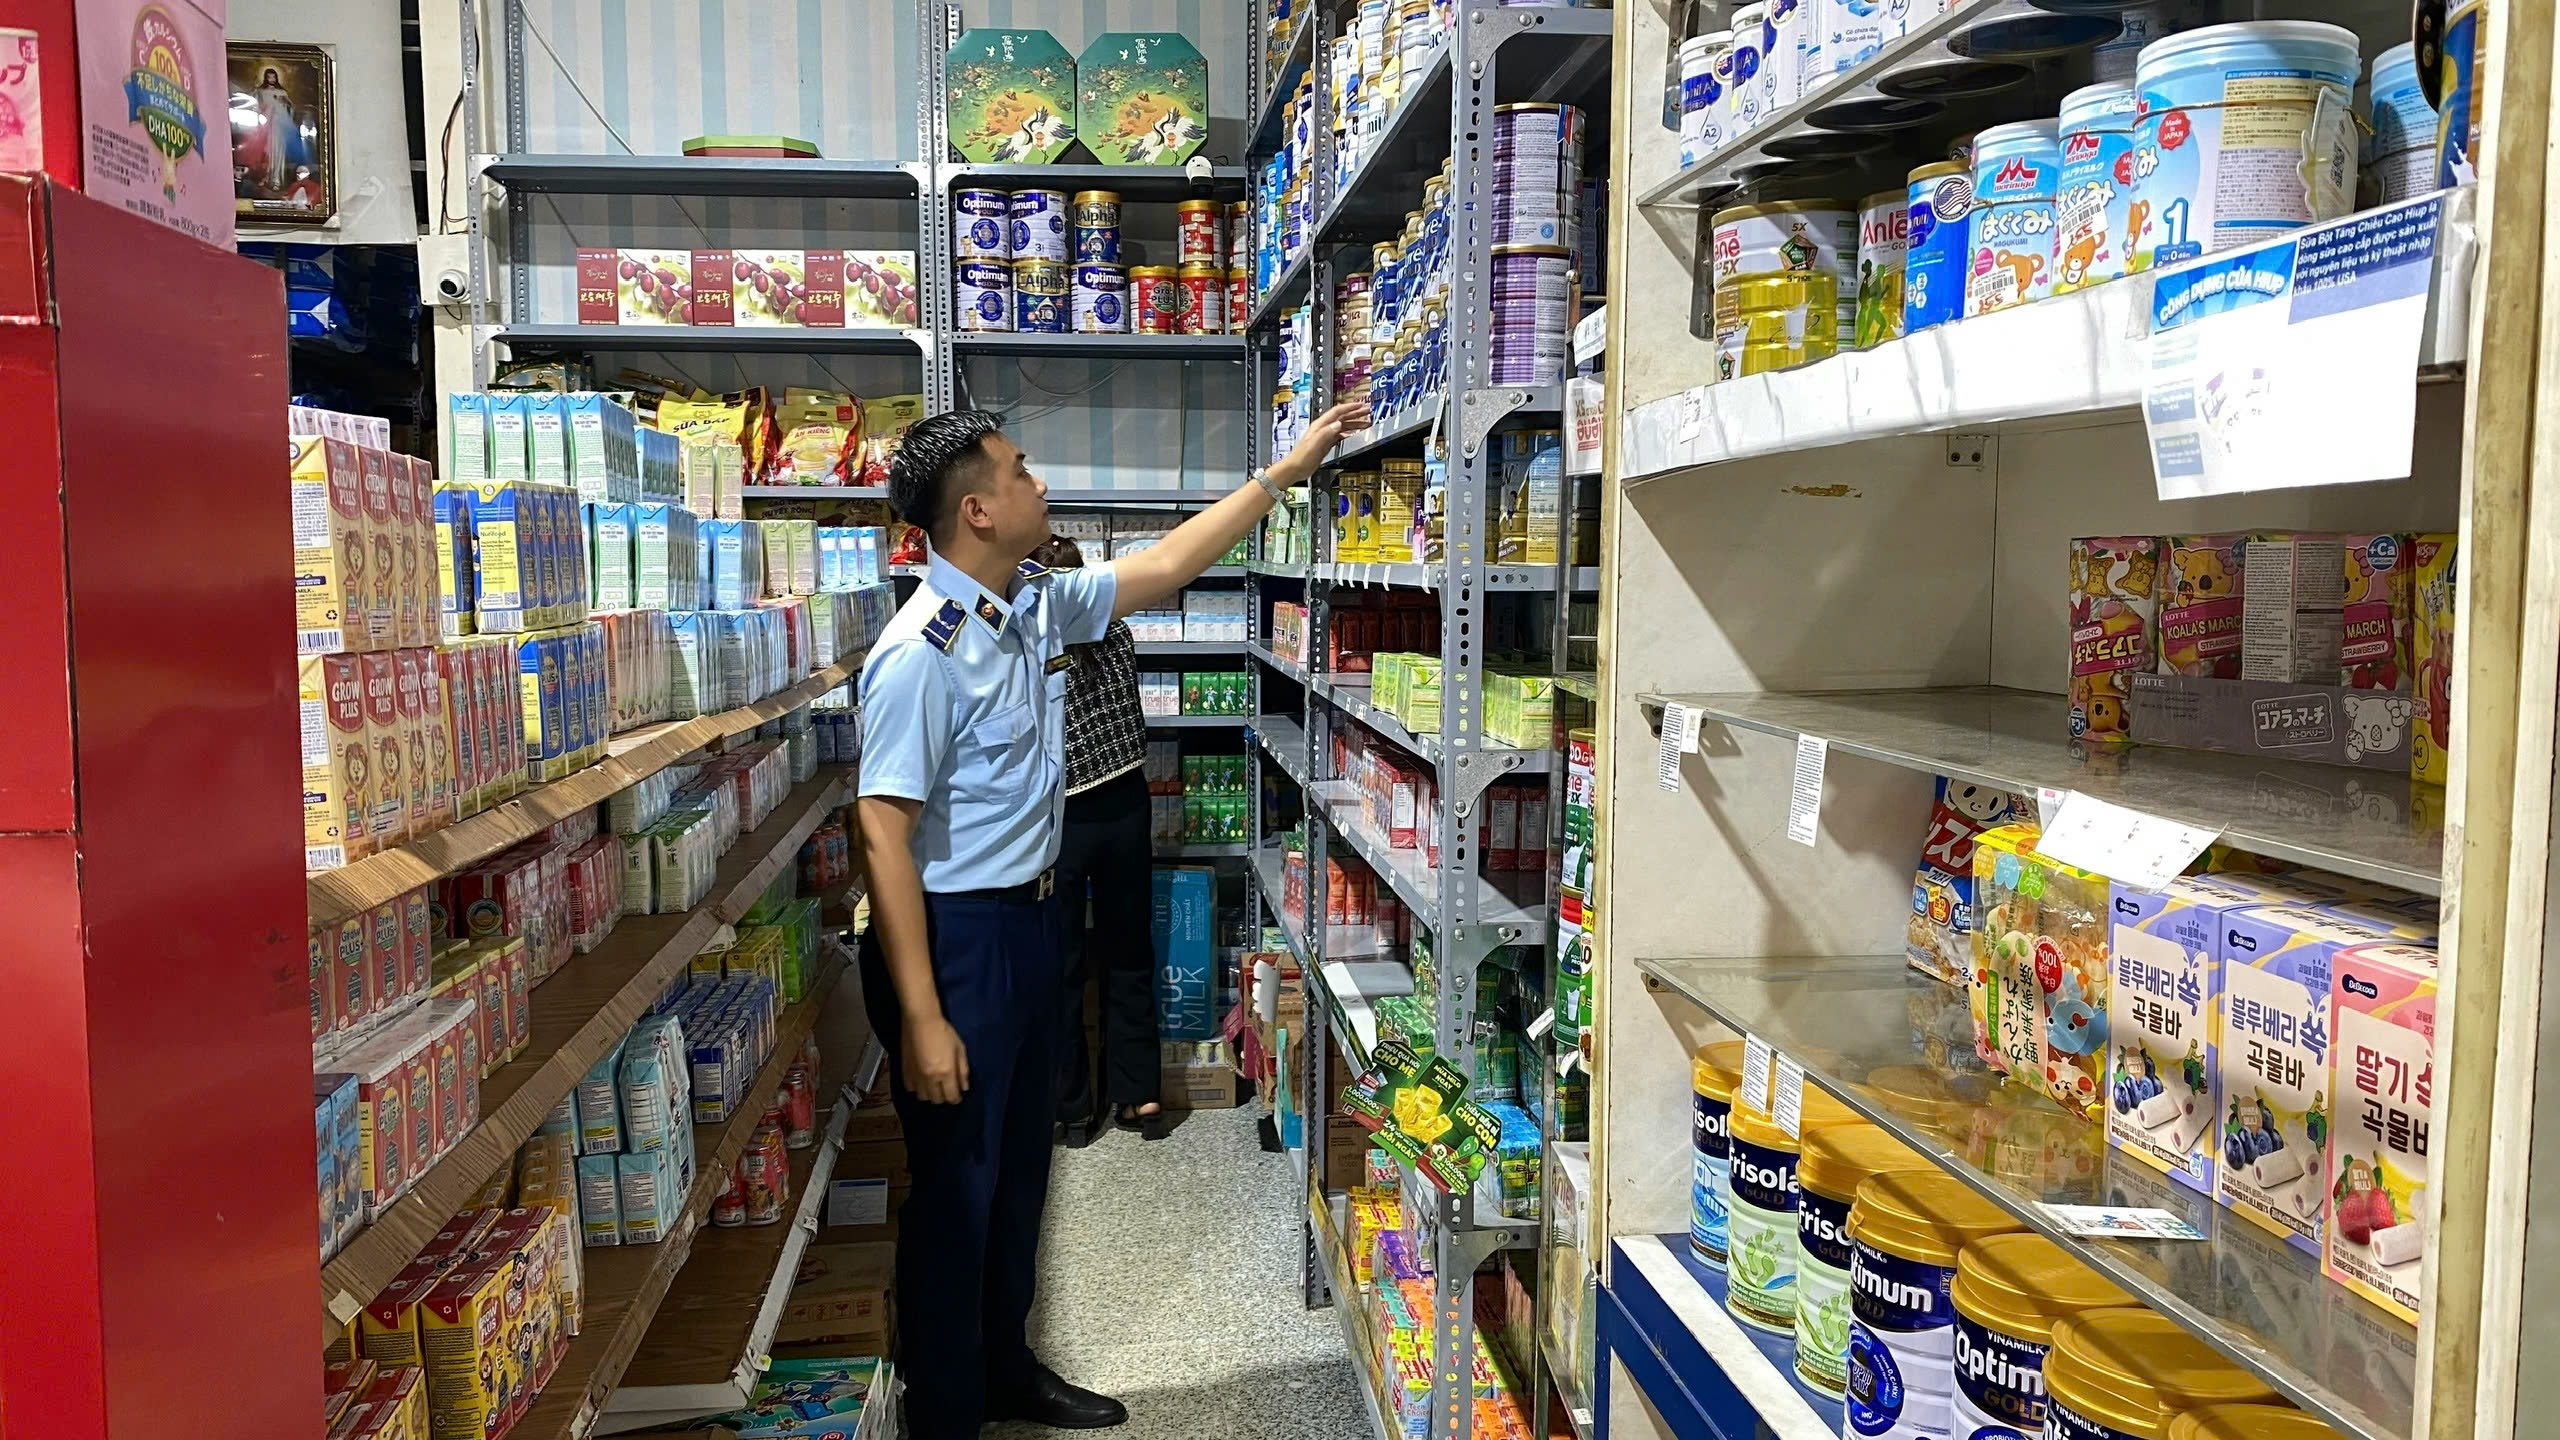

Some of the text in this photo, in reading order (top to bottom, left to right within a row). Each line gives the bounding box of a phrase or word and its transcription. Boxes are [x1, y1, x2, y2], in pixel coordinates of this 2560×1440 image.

[1899, 19, 1906, 37] 1
[1703, 128, 1717, 138] A2
[2165, 118, 2183, 127] Made
[2163, 131, 2184, 141] JAPAN
[1993, 180, 2035, 193] morinaga
[1791, 222, 1808, 232] 5X
[1979, 208, 2054, 245] はぐくみ
[2318, 232, 2333, 246] Bột
[2384, 213, 2404, 225] Cao
[2405, 205, 2428, 221] Hiup
[2338, 244, 2354, 255] cao
[1722, 260, 1738, 275] 5X
[2337, 271, 2357, 286] USA
[2253, 270, 2286, 297] HIUP
[2369, 542, 2396, 556] +Ca
[2165, 610, 2189, 622] LOTTE
[2166, 617, 2206, 641] KOALA'S
[2346, 619, 2386, 639] MARCH
[331, 681, 360, 702] GROW
[368, 678, 392, 697] GROW
[2135, 676, 2165, 689] LOTTE
[340, 701, 359, 719] PLUS
[2258, 705, 2325, 730] コアラのマーチ
[2288, 729, 2325, 739] ストロベリー
[2118, 955, 2175, 1001] 블루베리
[1159, 965, 1183, 1031] true
[1183, 966, 1206, 1031] MILK
[2131, 995, 2183, 1041] 곡물바
[2231, 994, 2297, 1048] 블루베리
[1374, 1048, 1417, 1080] CHO MẸ
[2246, 1040, 2306, 1092] 곡물바
[2356, 1045, 2409, 1104] 딸기
[1433, 1064, 1462, 1089] MUA MILO
[1455, 1106, 1498, 1150] CHO CON
[1988, 1330, 2044, 1354] VINAMILK
[1955, 1329, 2045, 1396] Optim
[2055, 1402, 2103, 1438] VINAMILK
